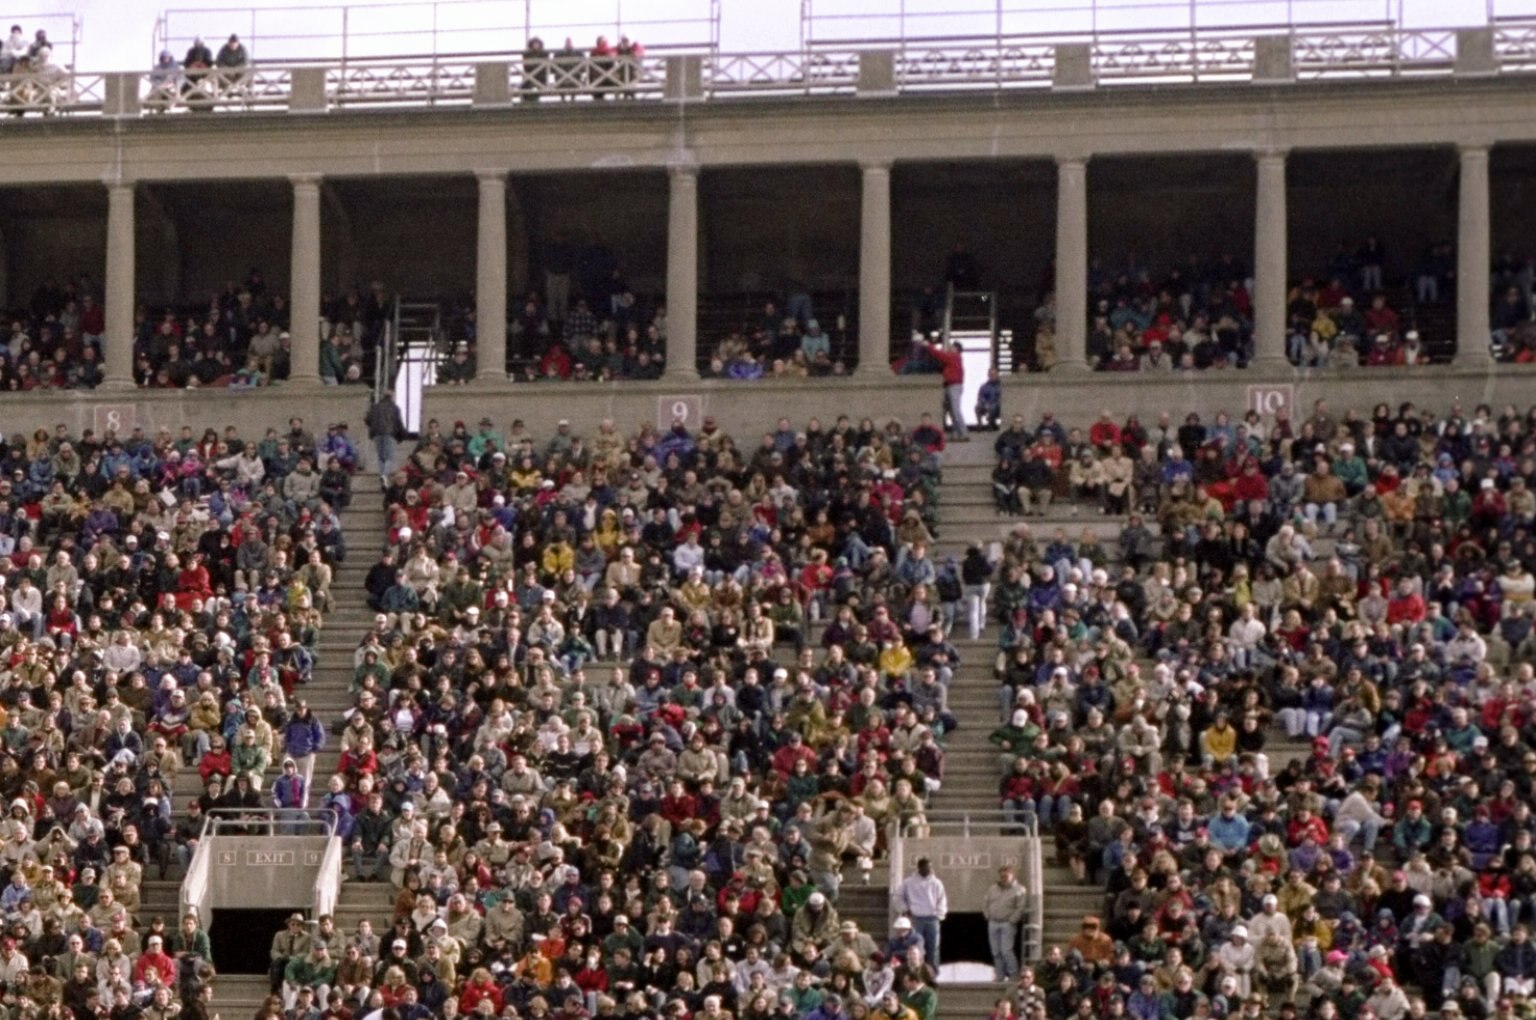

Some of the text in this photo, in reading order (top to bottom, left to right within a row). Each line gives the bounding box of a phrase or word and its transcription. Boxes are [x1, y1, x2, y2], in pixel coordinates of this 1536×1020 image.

[672, 401, 688, 422] 9
[1255, 390, 1284, 414] 10
[107, 410, 121, 432] 8
[255, 853, 285, 864] EXIT
[310, 853, 319, 864] 9
[949, 855, 980, 866] EXIT
